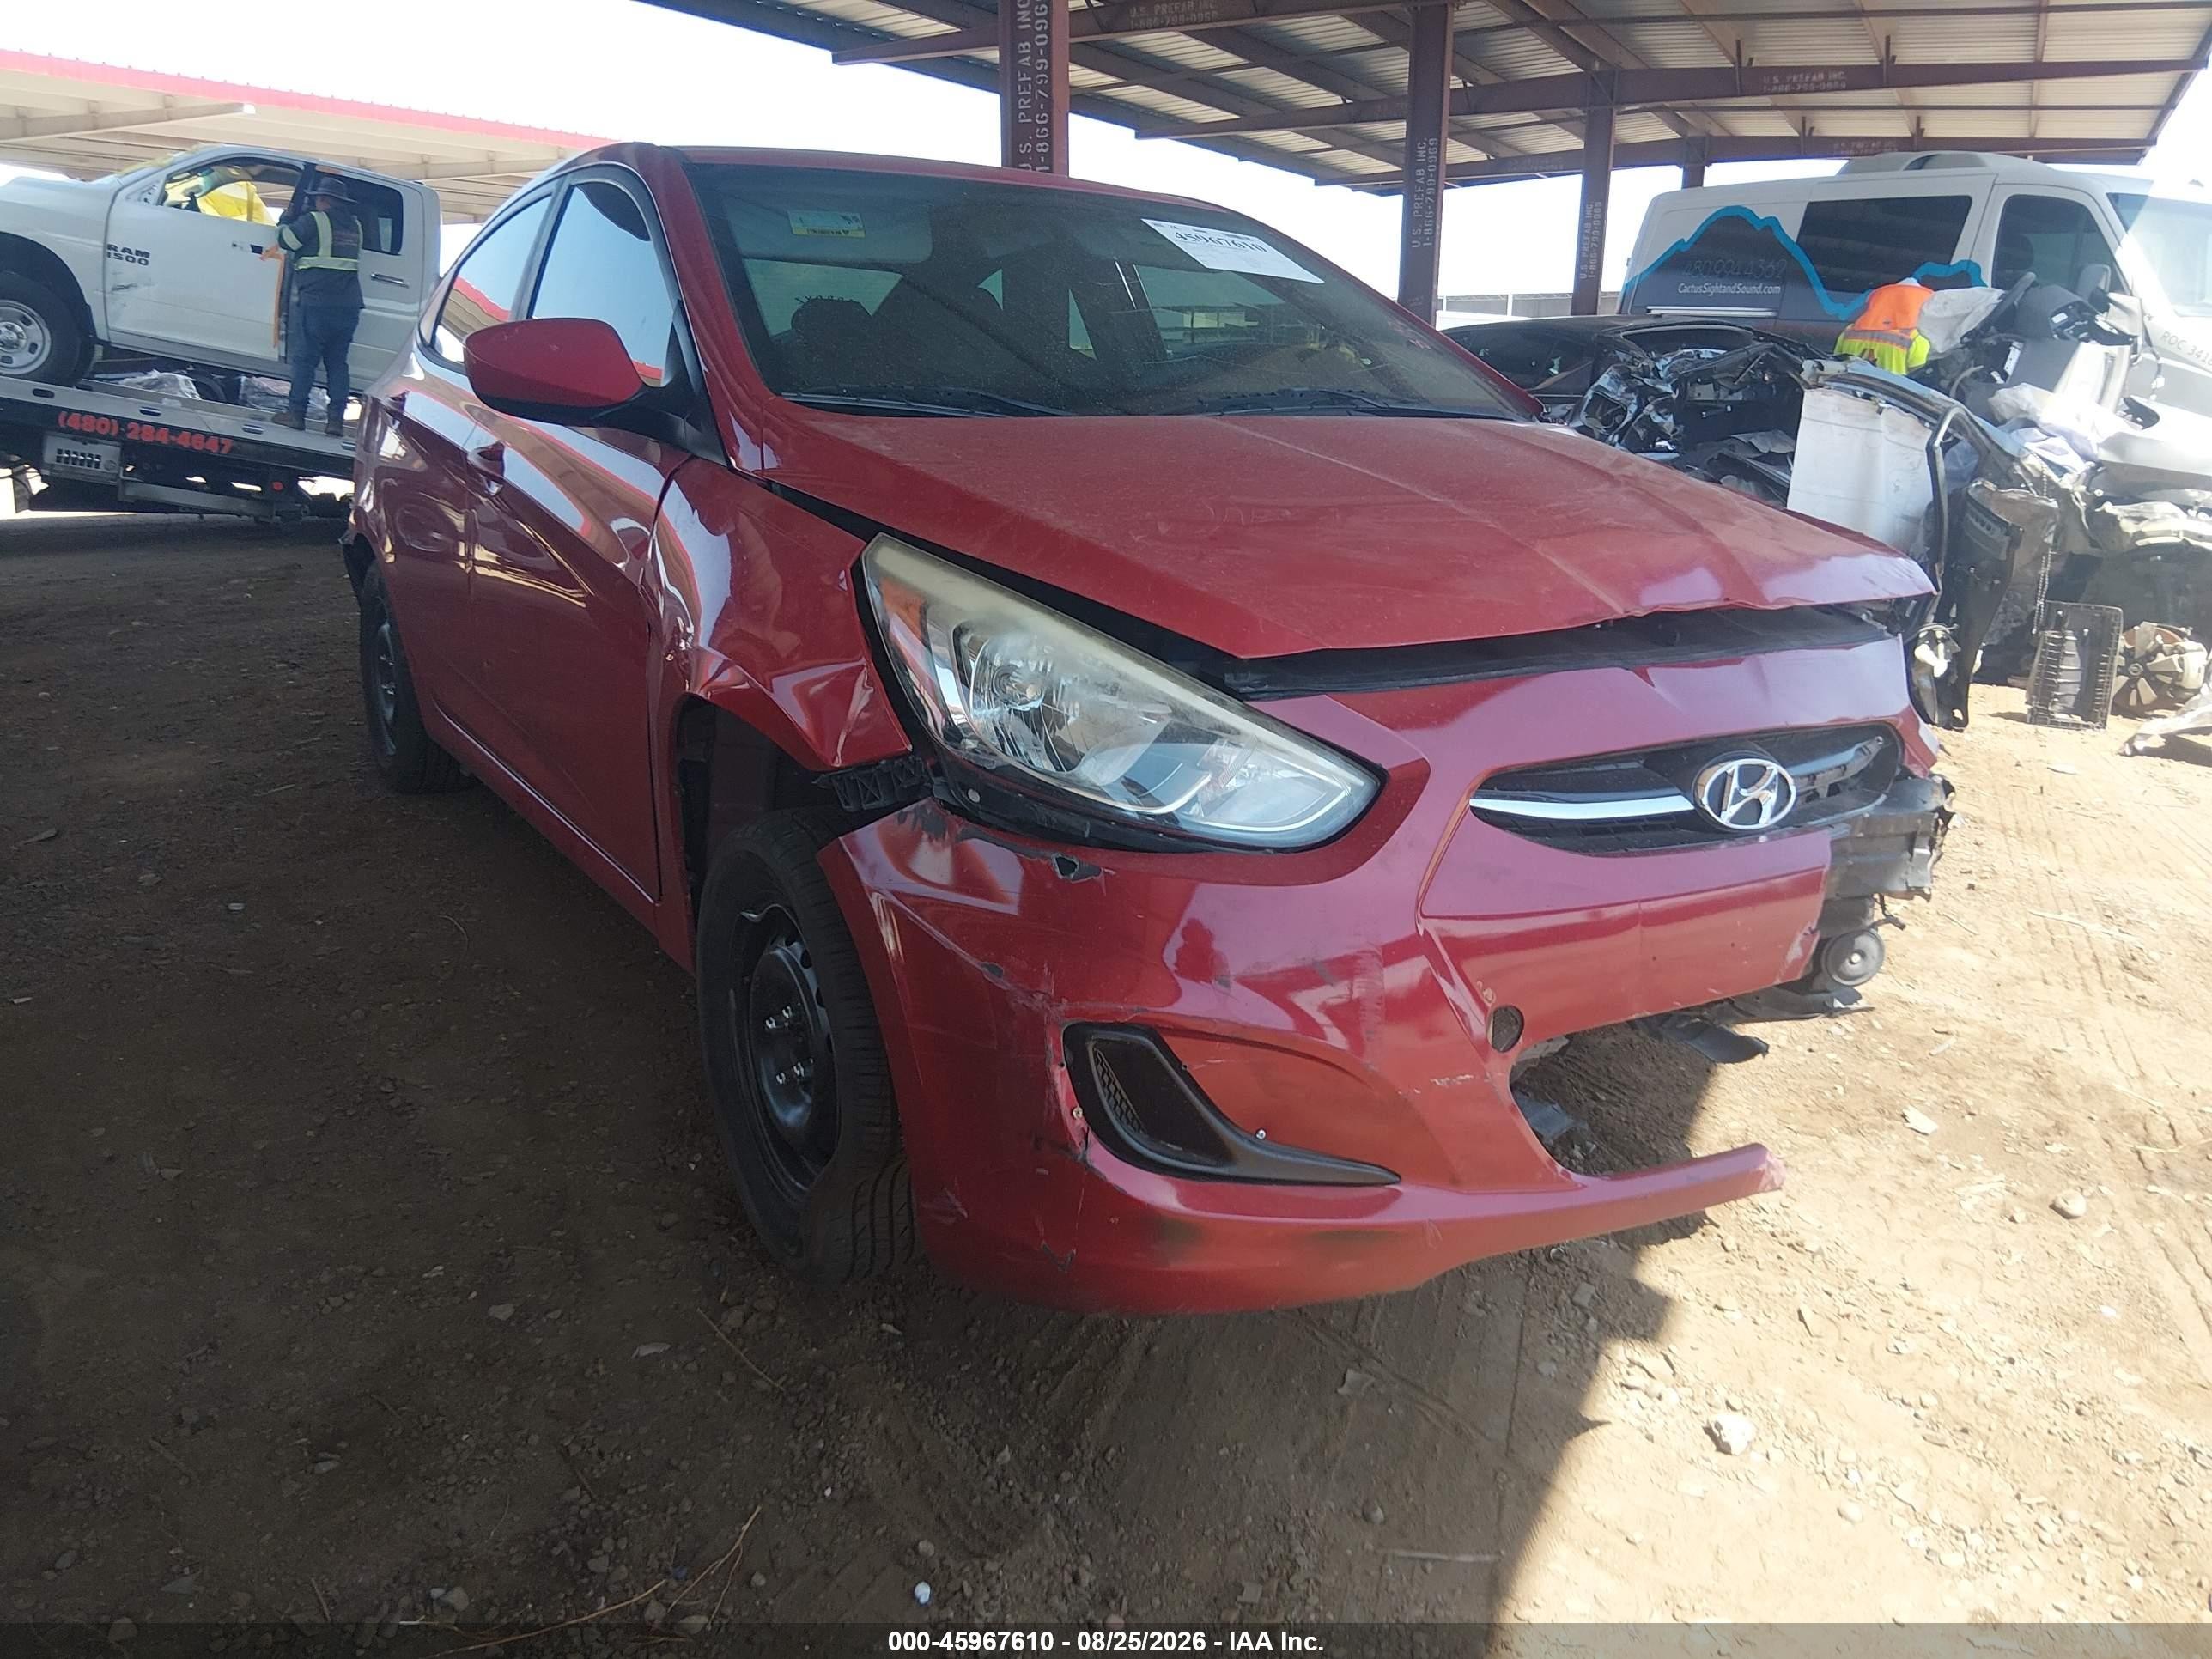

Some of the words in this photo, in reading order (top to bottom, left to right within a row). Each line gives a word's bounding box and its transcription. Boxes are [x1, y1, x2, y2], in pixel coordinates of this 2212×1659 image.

[1017, 40, 1032, 123] PREFAB
[1035, 0, 1050, 172] 1-866-799-096
[1413, 168, 1425, 217] PREFAB
[106, 243, 150, 258] RAM
[106, 252, 149, 266] 1500
[1677, 283, 1782, 297] CactusSightandSound.com
[2160, 331, 2186, 351] ROC
[58, 410, 119, 437] (480)
